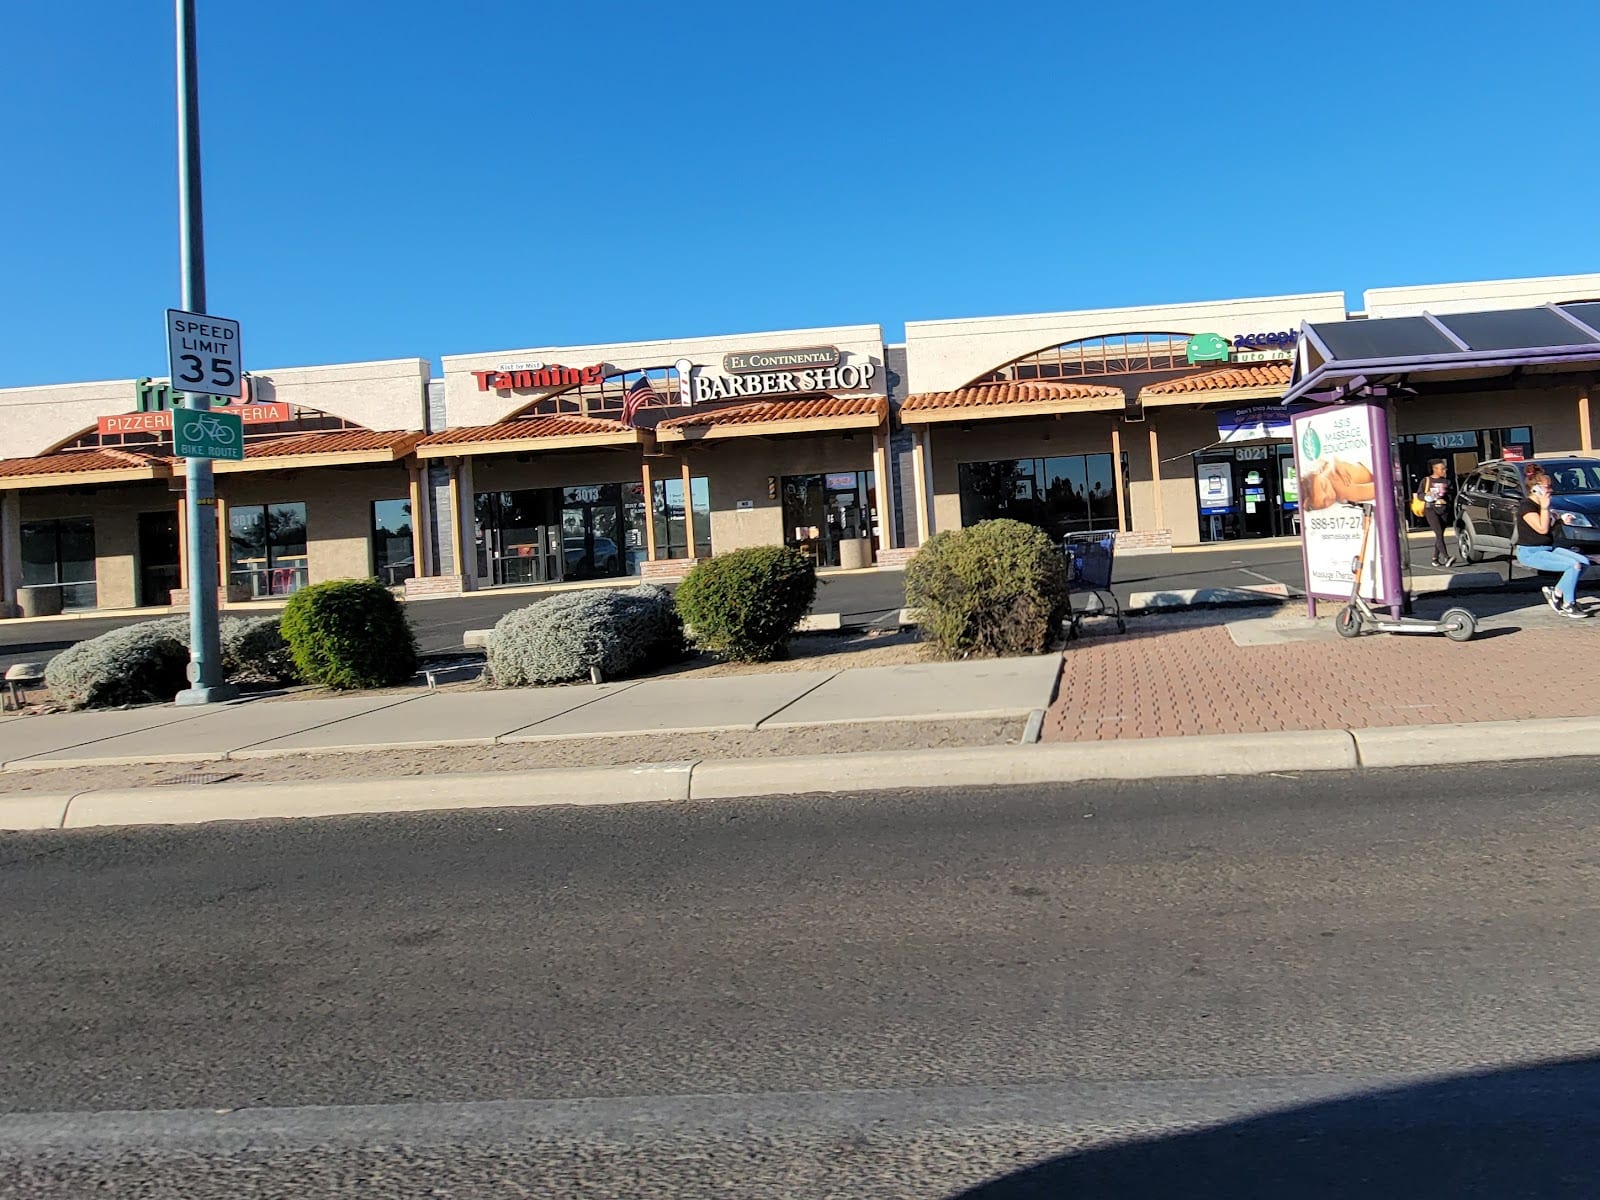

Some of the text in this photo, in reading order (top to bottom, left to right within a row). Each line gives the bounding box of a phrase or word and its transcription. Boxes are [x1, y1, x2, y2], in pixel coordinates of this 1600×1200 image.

[175, 320, 234, 340] SPEED
[182, 337, 228, 355] LIMIT
[1232, 353, 1265, 363] auto
[179, 354, 235, 387] 35
[471, 362, 604, 392] Tanning
[694, 364, 875, 402] BARBER SHOP
[1267, 404, 1288, 412] Around
[107, 415, 173, 431] PIZZERI
[1325, 427, 1361, 440] MASSAGE
[1432, 434, 1465, 448] 3023
[181, 444, 238, 458] BIKE ROUTE
[1235, 446, 1268, 461] 3021
[1323, 438, 1368, 454] EDUCATION
[574, 487, 599, 502] 3013
[232, 513, 258, 526] 3011
